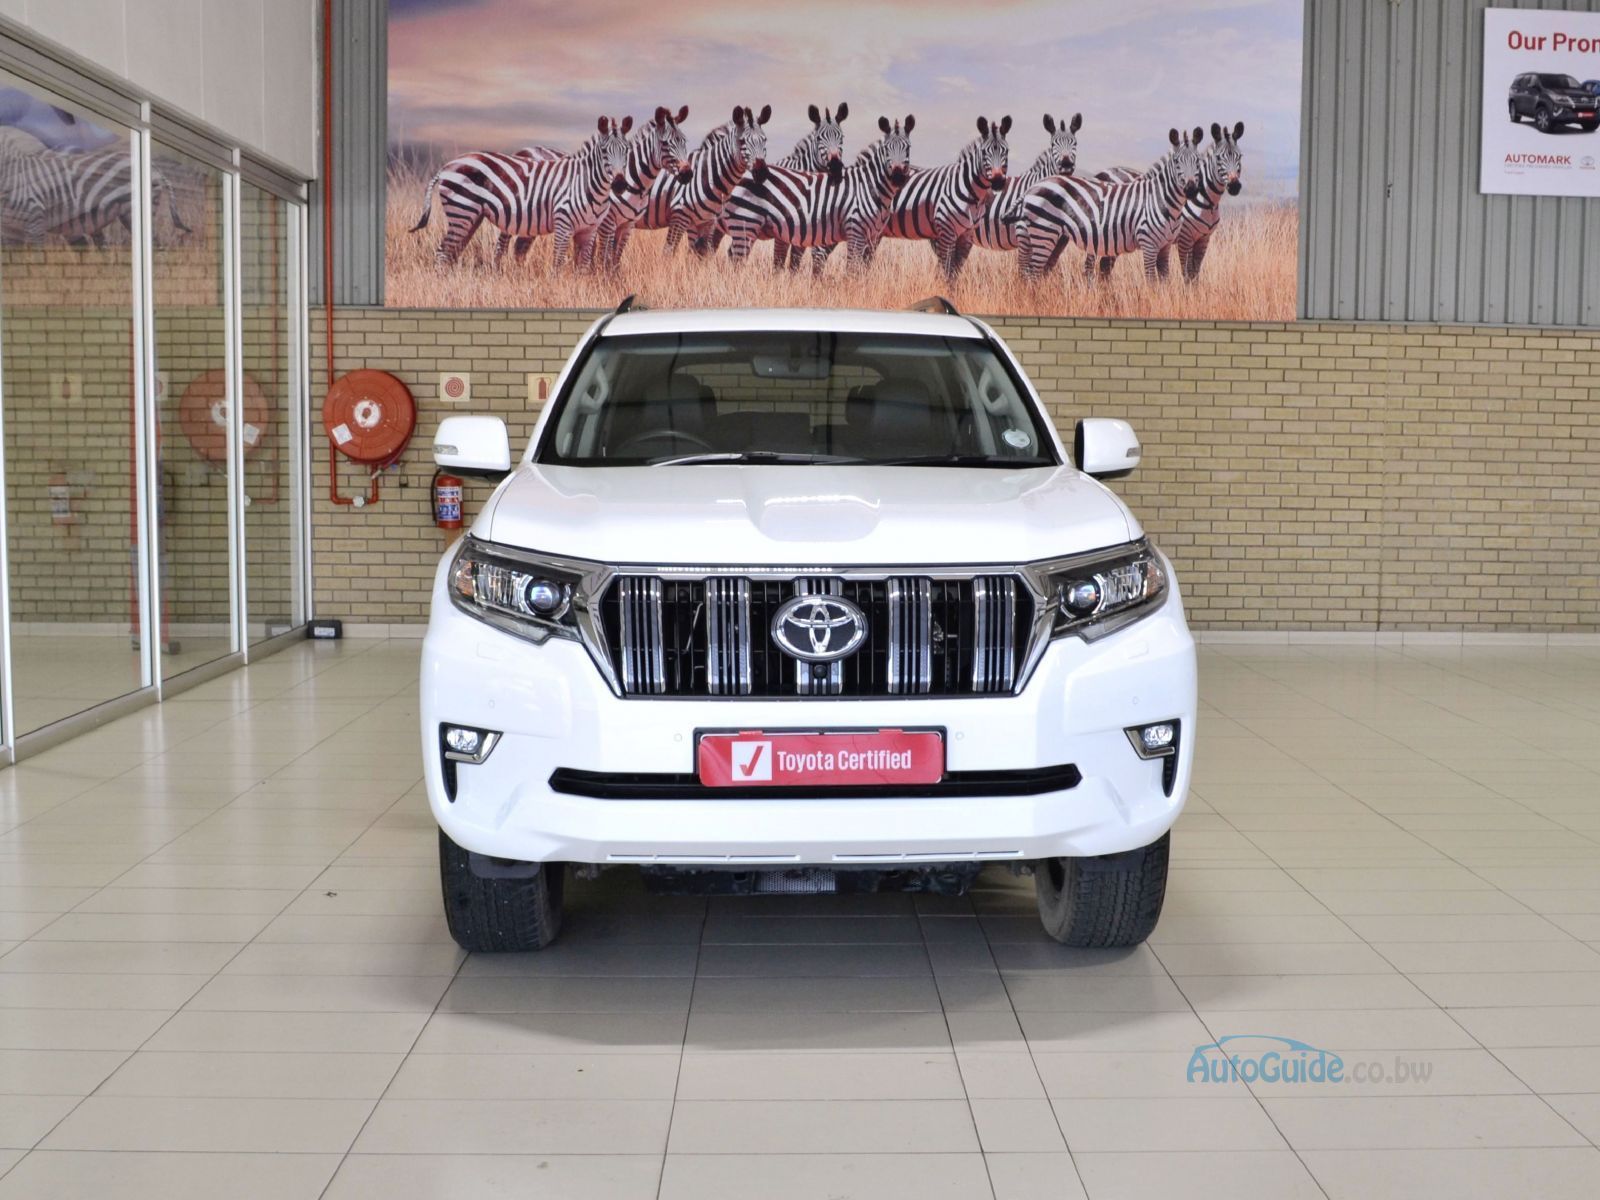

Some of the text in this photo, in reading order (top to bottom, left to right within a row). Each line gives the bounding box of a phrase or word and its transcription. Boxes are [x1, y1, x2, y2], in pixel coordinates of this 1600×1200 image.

[1508, 30, 1547, 51] Our
[1504, 153, 1572, 165] AUTOMARK
[777, 750, 912, 773] Toyota Certified
